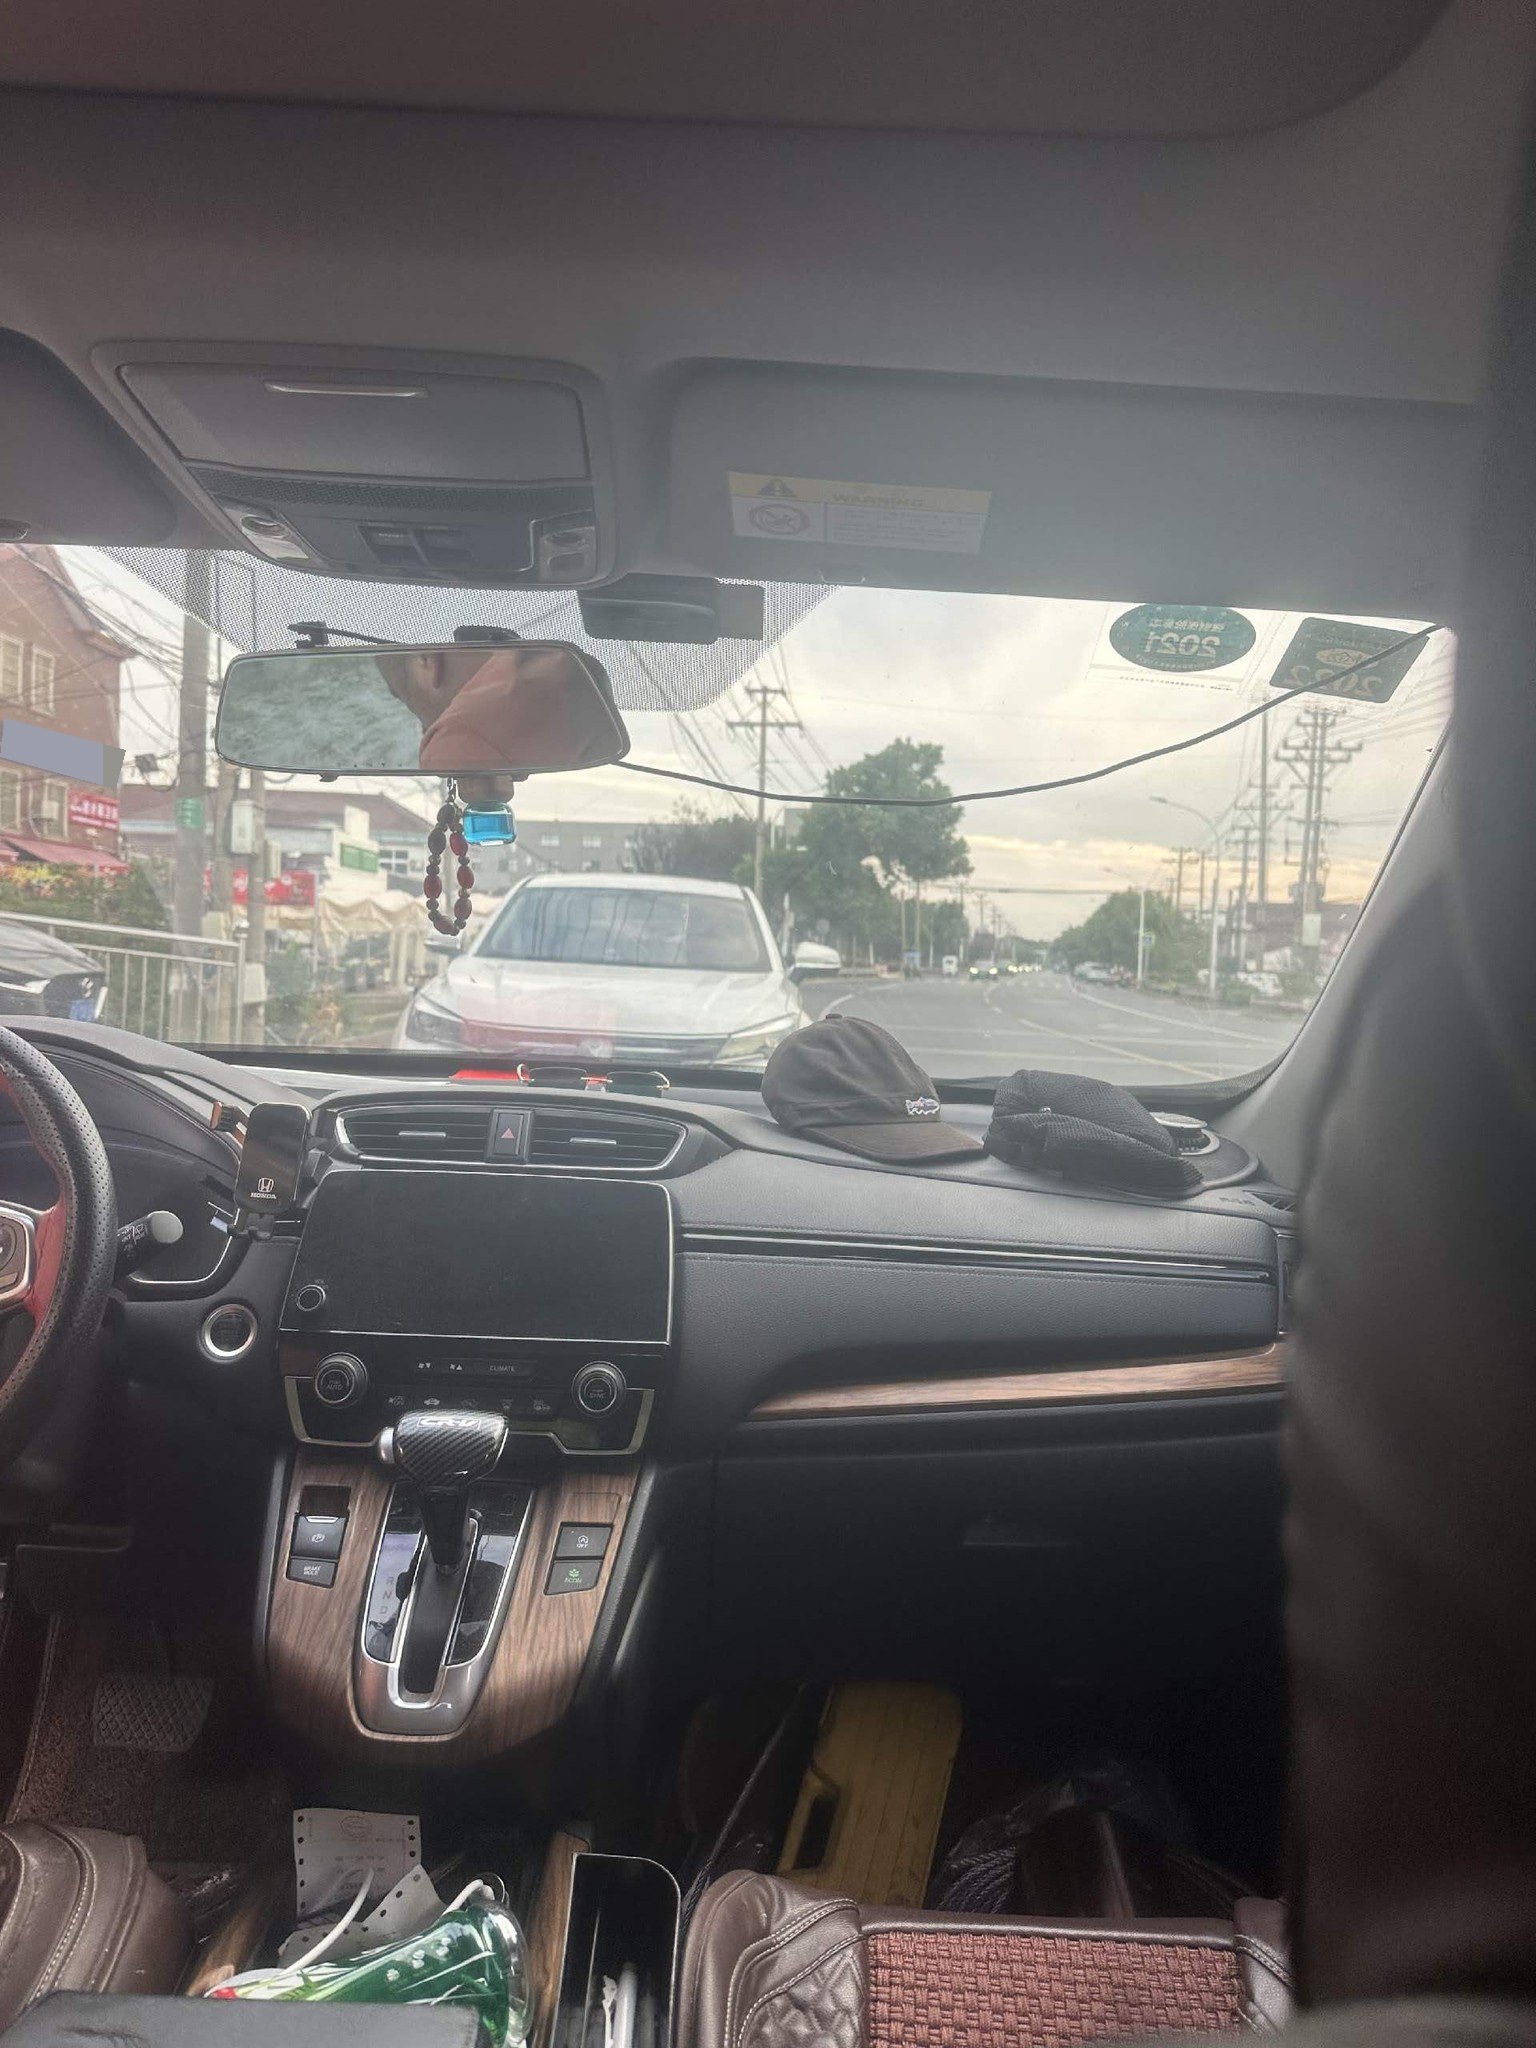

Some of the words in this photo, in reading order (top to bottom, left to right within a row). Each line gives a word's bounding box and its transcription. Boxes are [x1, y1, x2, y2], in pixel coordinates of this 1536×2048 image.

[489, 1364, 515, 1372] CLIMATE
[326, 1383, 344, 1391] AUTO
[421, 1416, 478, 1428] CR-V
[383, 1591, 392, 1600] N
